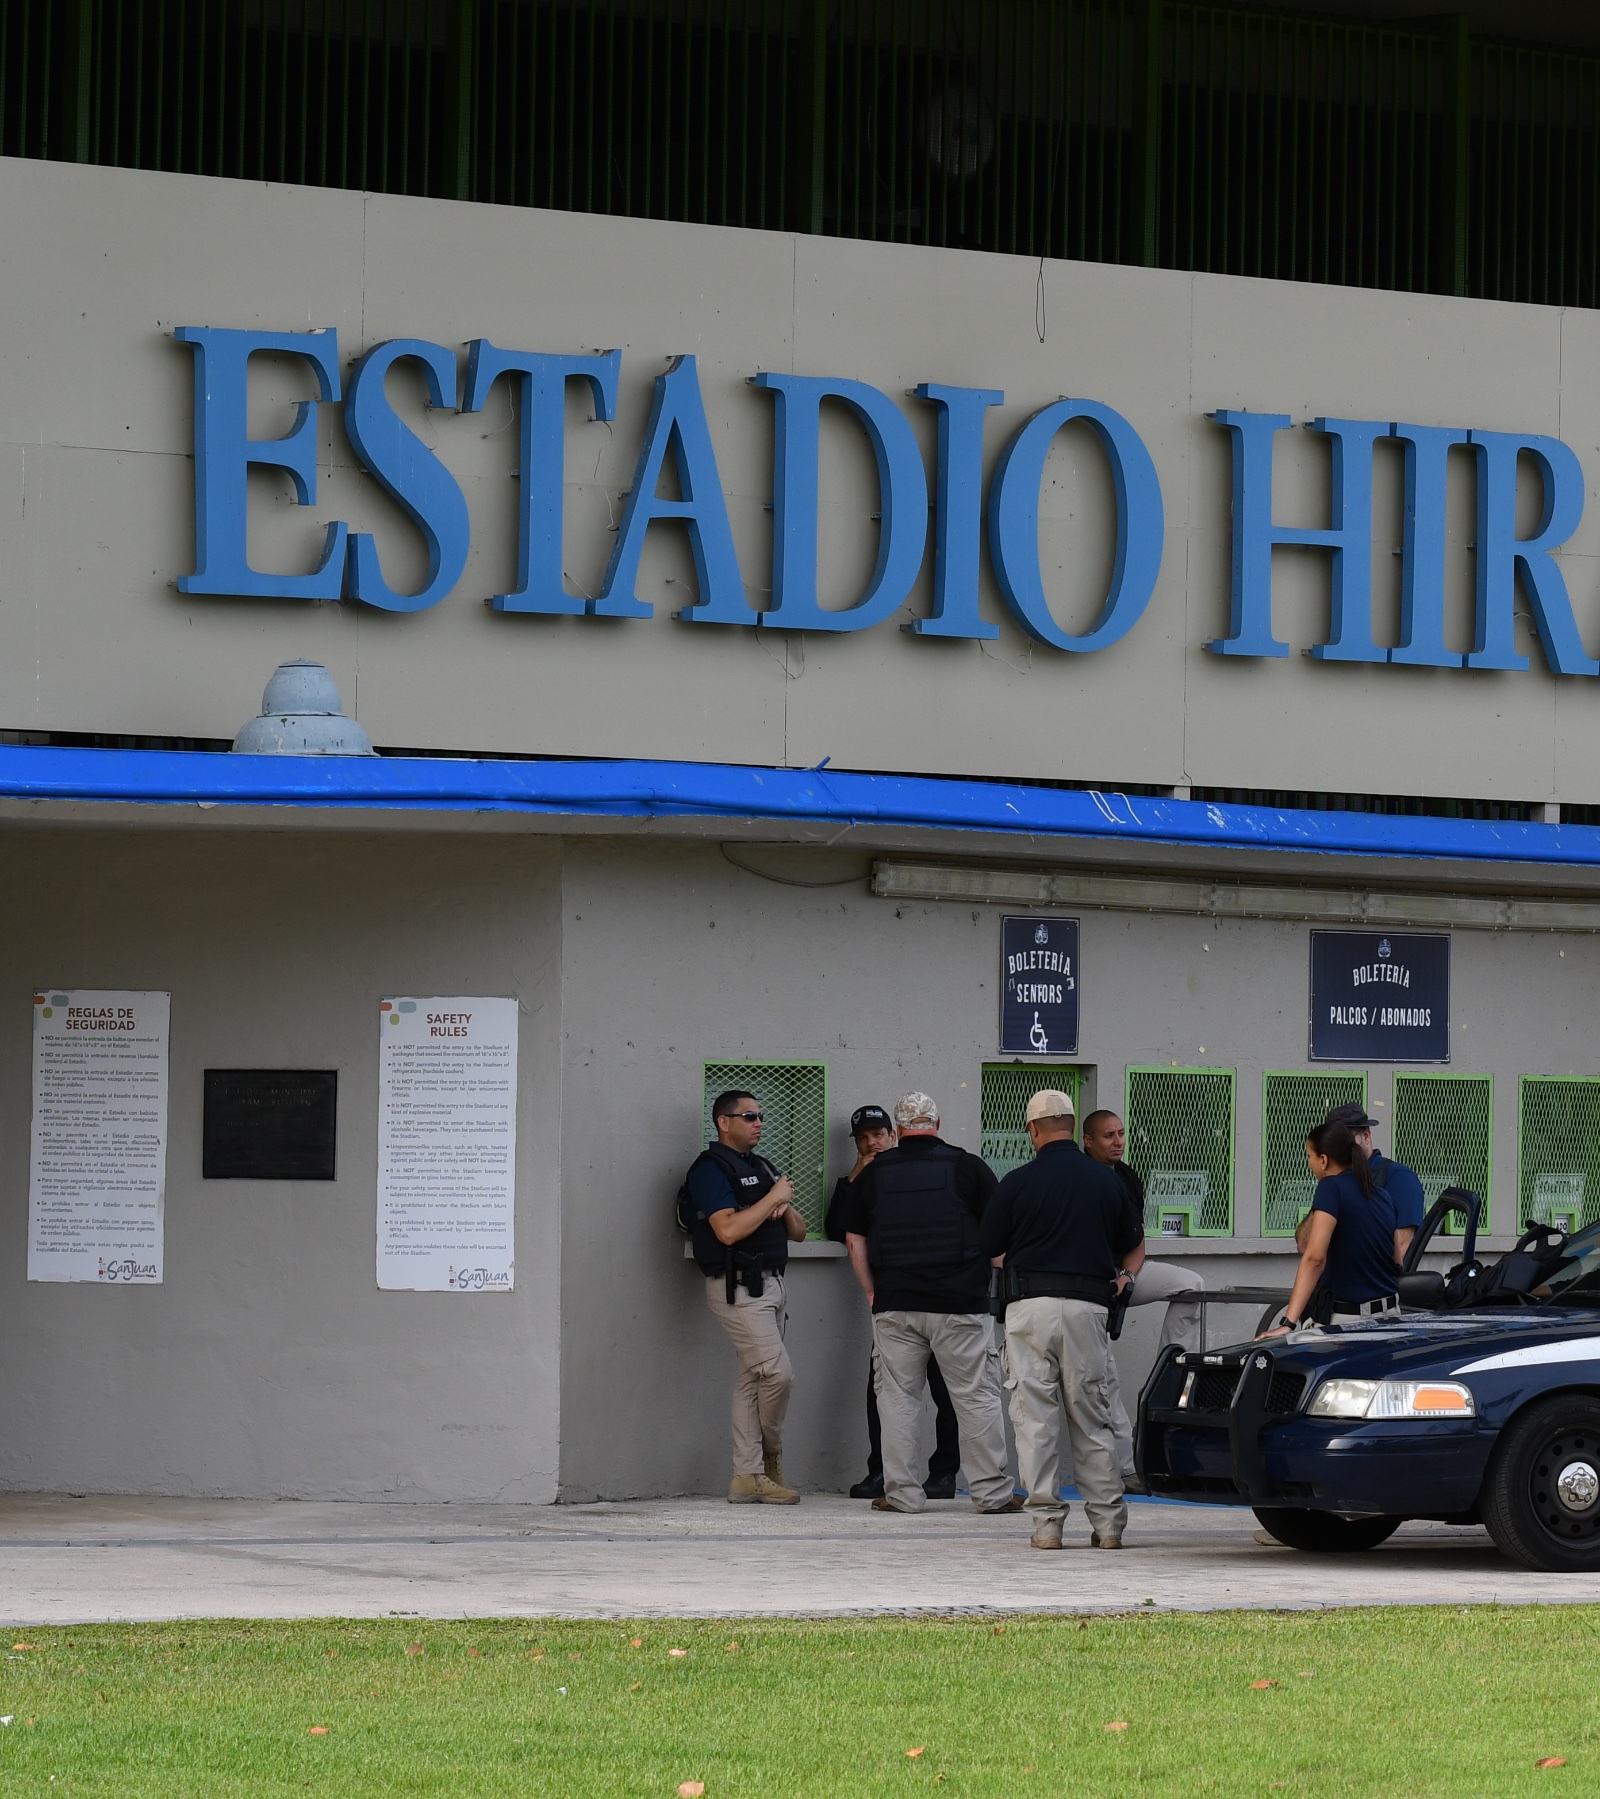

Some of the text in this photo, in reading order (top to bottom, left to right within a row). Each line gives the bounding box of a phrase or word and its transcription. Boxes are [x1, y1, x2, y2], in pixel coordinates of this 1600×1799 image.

[175, 326, 1165, 654] ESTADIO
[1008, 950, 1070, 976] BOLETERÍA
[1352, 963, 1410, 988] BOLETERÍA
[68, 1007, 134, 1018] REGLAS DE
[1330, 1006, 1431, 1026] PALCOS / ABONADOS
[426, 1013, 472, 1024] SAFETY
[65, 1019, 135, 1030] SEGURIDAD
[430, 1026, 468, 1037] RULES
[1162, 1220, 1182, 1231] ERRADO
